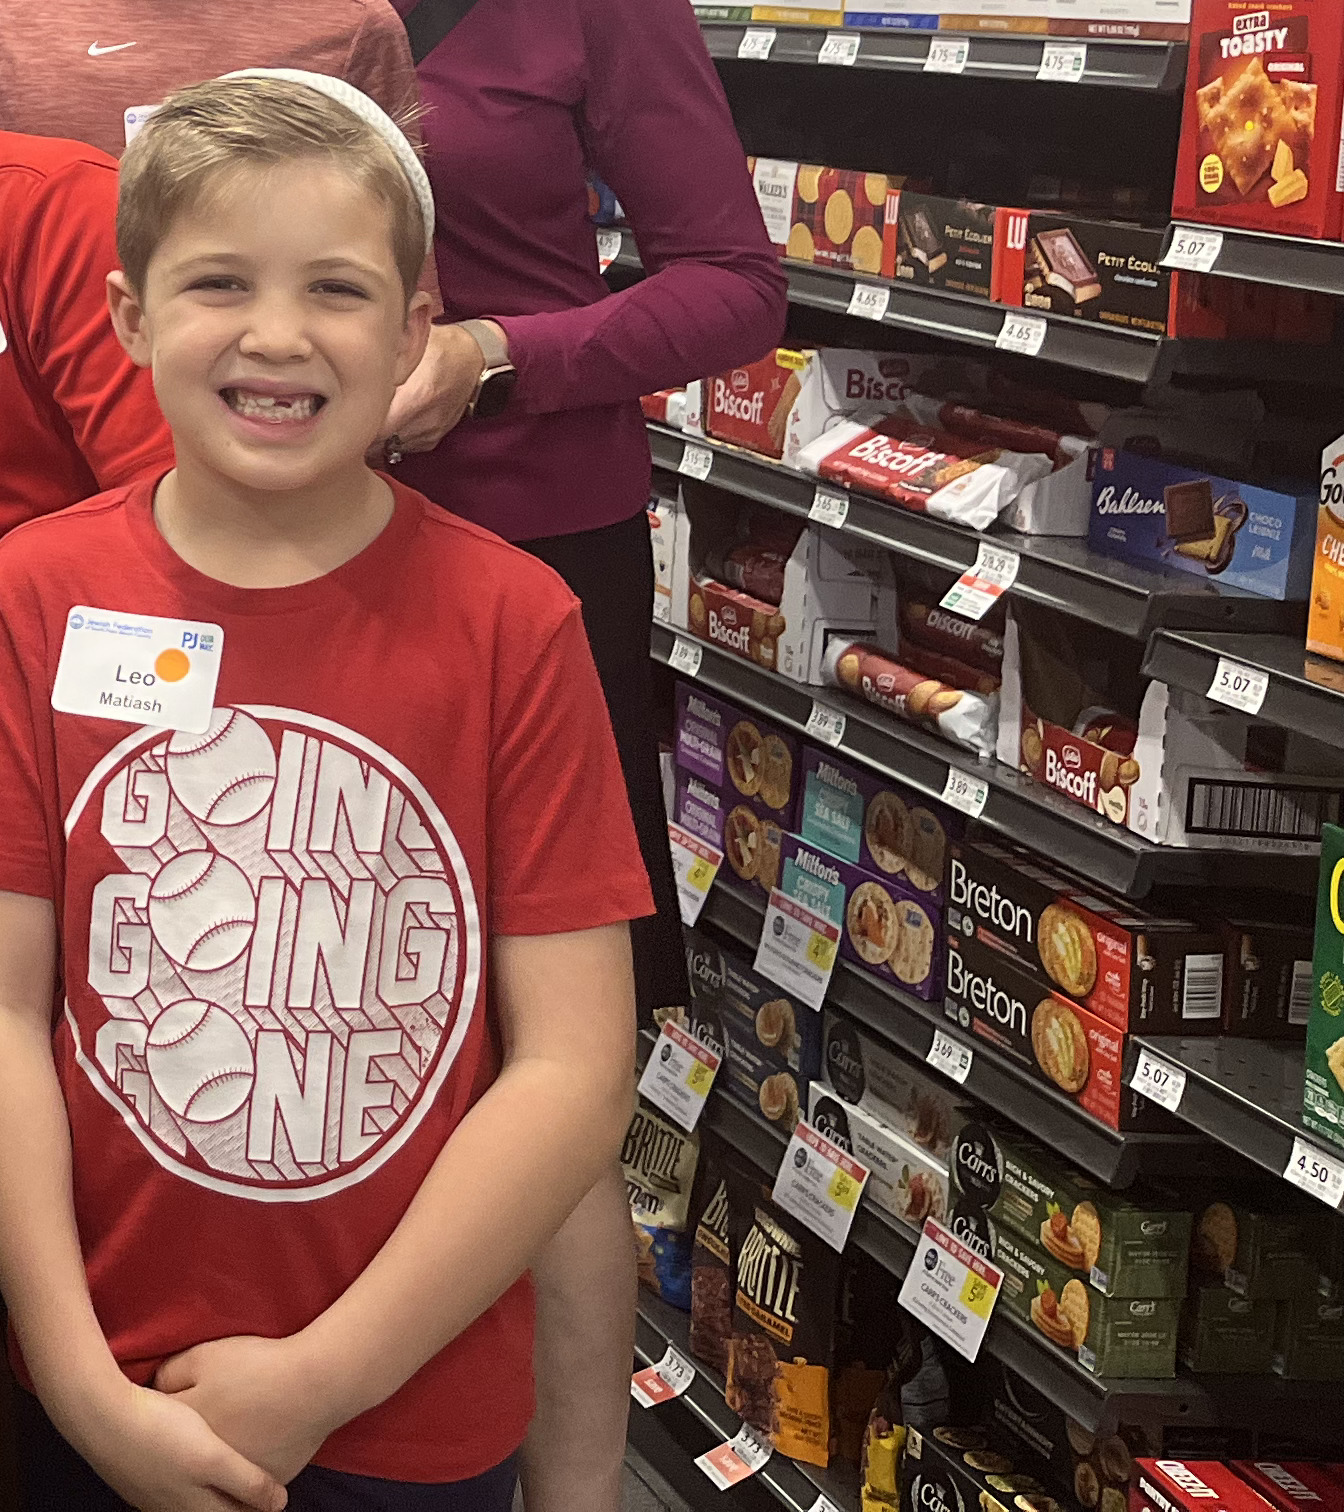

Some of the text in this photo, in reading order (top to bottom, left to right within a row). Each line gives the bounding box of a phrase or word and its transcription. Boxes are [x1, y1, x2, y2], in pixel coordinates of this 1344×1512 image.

[1008, 216, 1026, 250] LU
[1175, 240, 1205, 254] 5.07
[1006, 324, 1030, 341] 4.65
[714, 381, 764, 424] Biscoff
[849, 435, 934, 476] Biscoff
[1096, 487, 1166, 515] Bahlsen
[181, 632, 198, 649] PJ
[709, 609, 750, 651] Biscoff
[116, 665, 155, 686] Leo
[1220, 671, 1250, 692] 5.07
[99, 692, 162, 713] Matiash
[1046, 762, 1095, 808] Biscoff
[950, 860, 1032, 941] Breton
[948, 950, 1025, 1035] Breton
[1142, 1061, 1168, 1086] 5.07
[1298, 1155, 1328, 1182] 4.50
